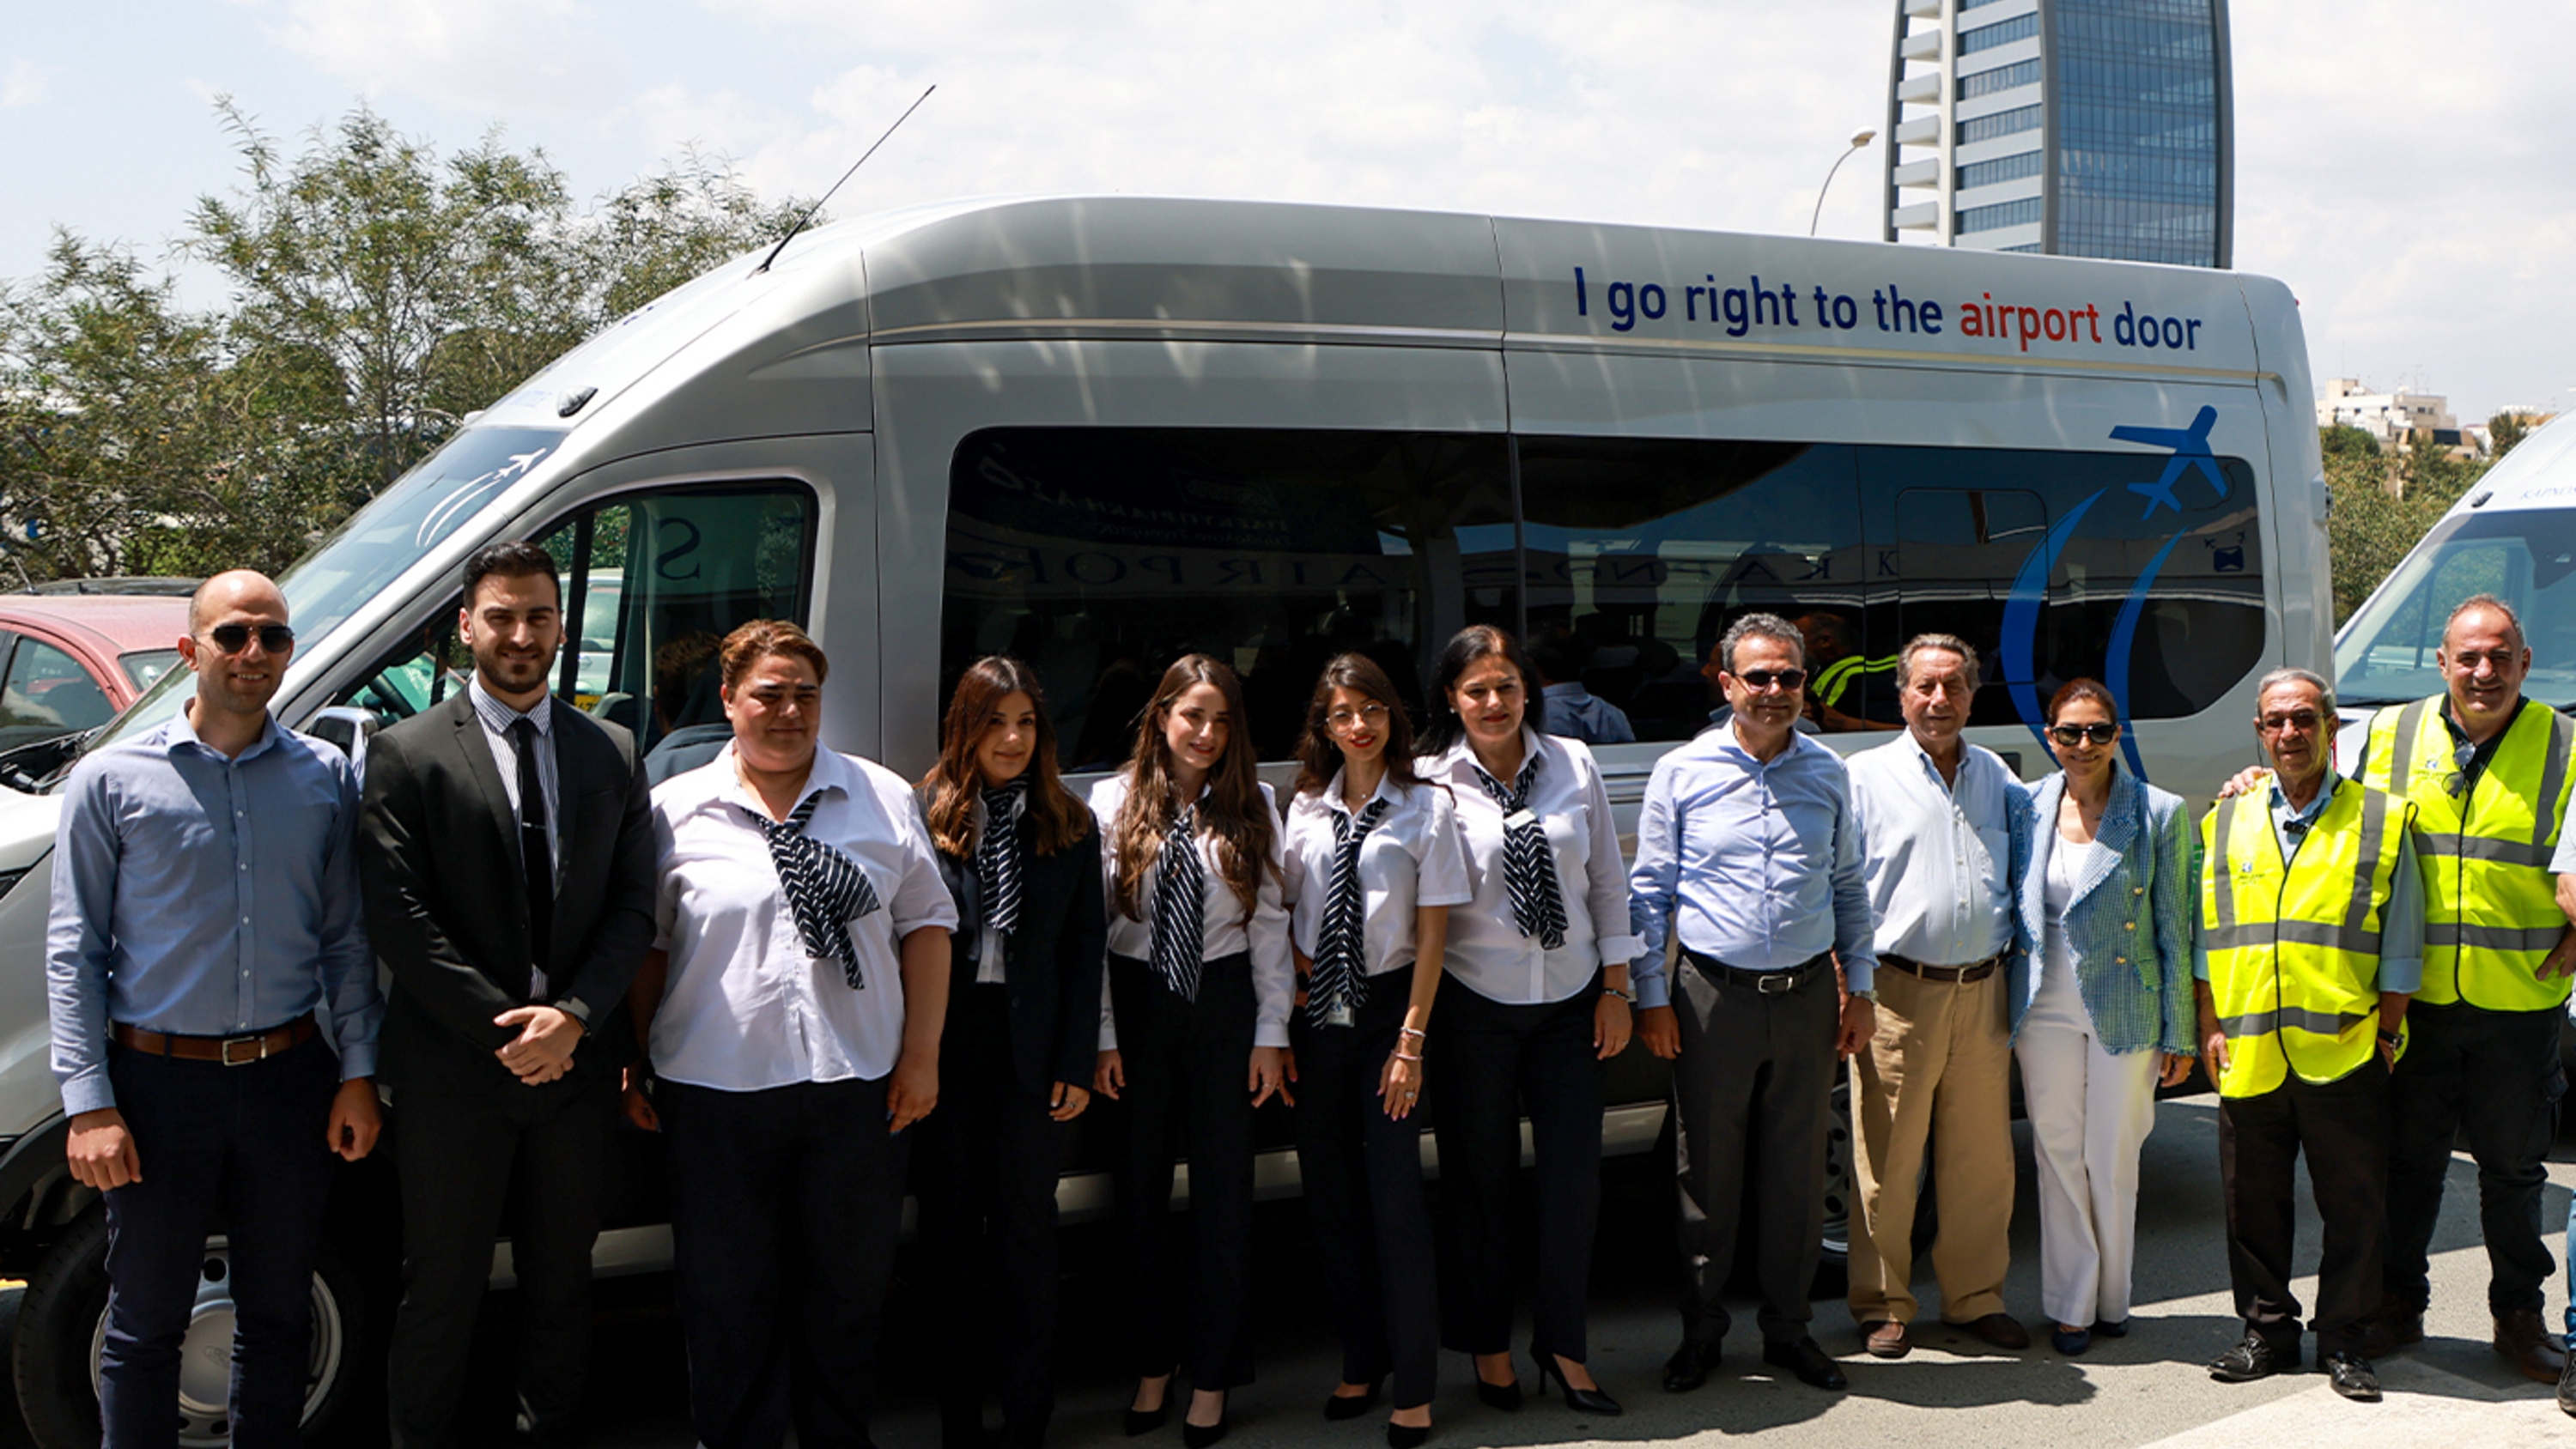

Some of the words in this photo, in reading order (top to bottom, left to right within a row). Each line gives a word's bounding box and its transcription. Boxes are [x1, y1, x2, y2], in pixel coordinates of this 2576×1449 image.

[1573, 266, 1588, 317] I
[1607, 281, 1668, 332] go
[1685, 274, 1800, 338] right
[1813, 285, 1857, 330] to
[1872, 283, 1943, 334] the
[1959, 292, 2102, 352] airport
[2113, 300, 2202, 350] door
